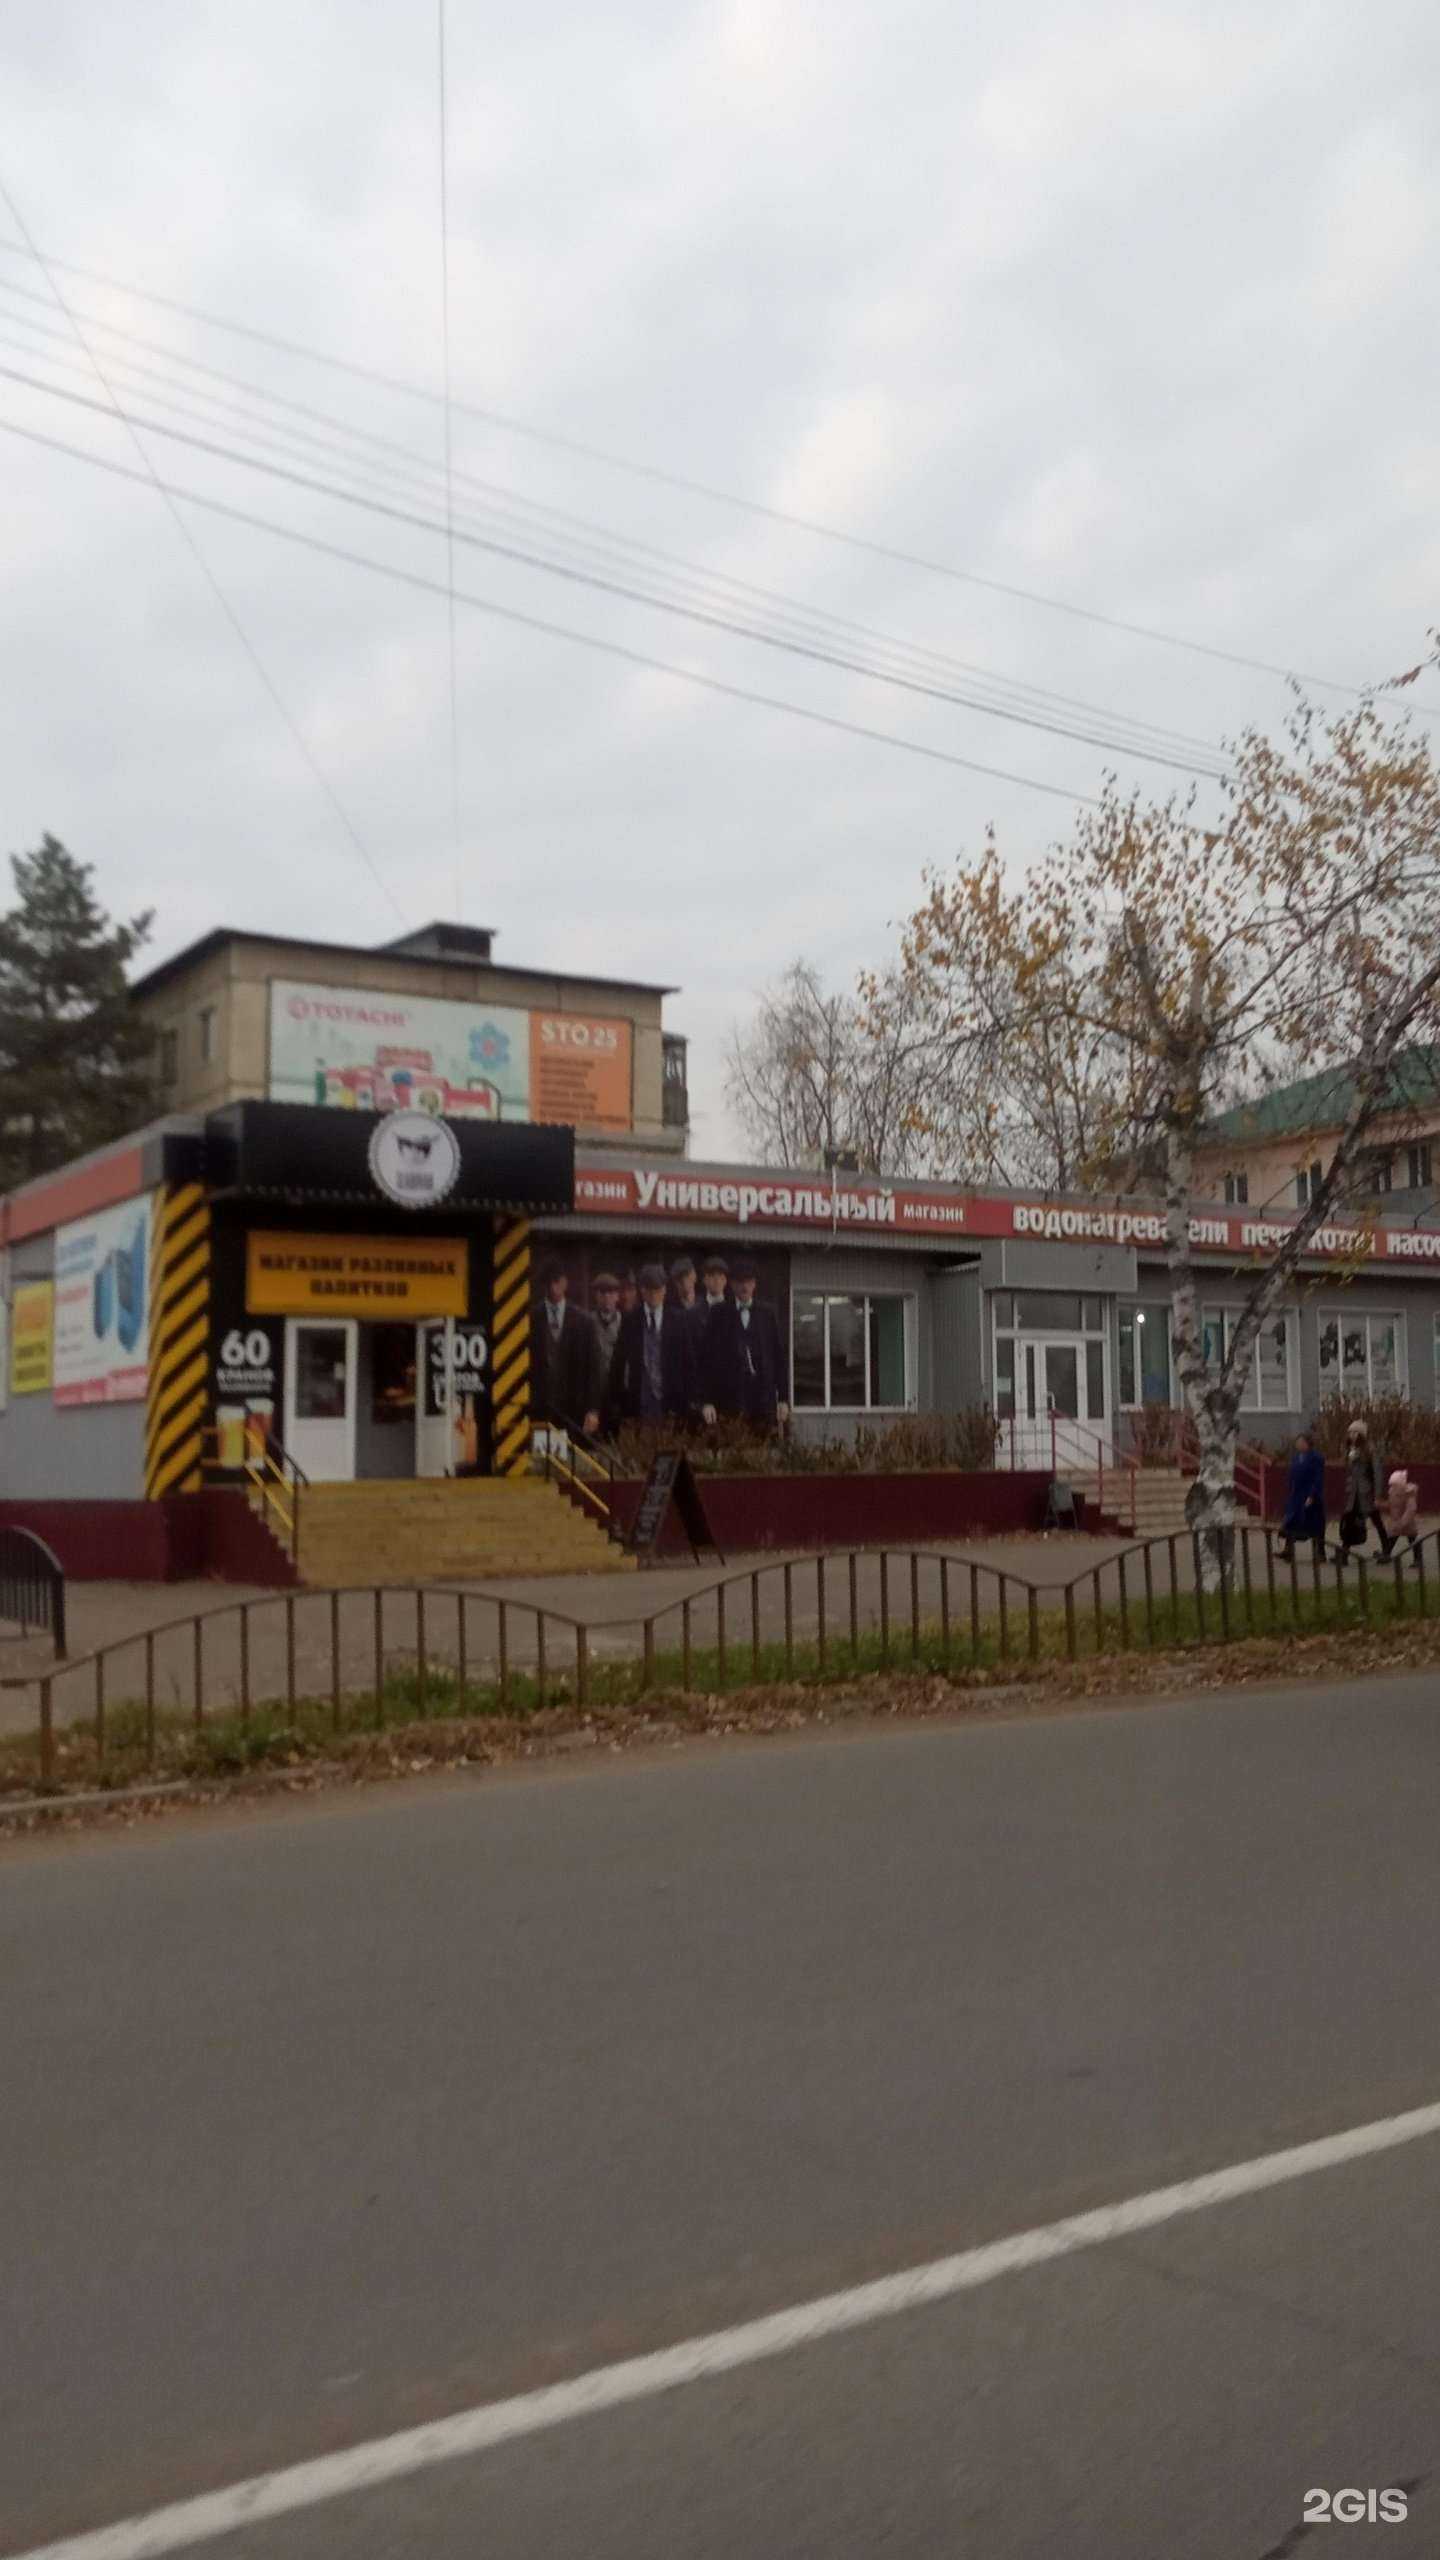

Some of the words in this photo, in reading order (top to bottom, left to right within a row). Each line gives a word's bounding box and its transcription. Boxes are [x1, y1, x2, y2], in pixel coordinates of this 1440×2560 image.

[575, 1180, 627, 1198] газин
[633, 1170, 896, 1223] Универсальный
[903, 1203, 964, 1222] магазин
[1013, 1206, 1229, 1244] водонагреваели
[259, 1254, 344, 1270] МАГАЗИН
[221, 1329, 271, 1366] 60
[430, 1334, 487, 1367] 300
